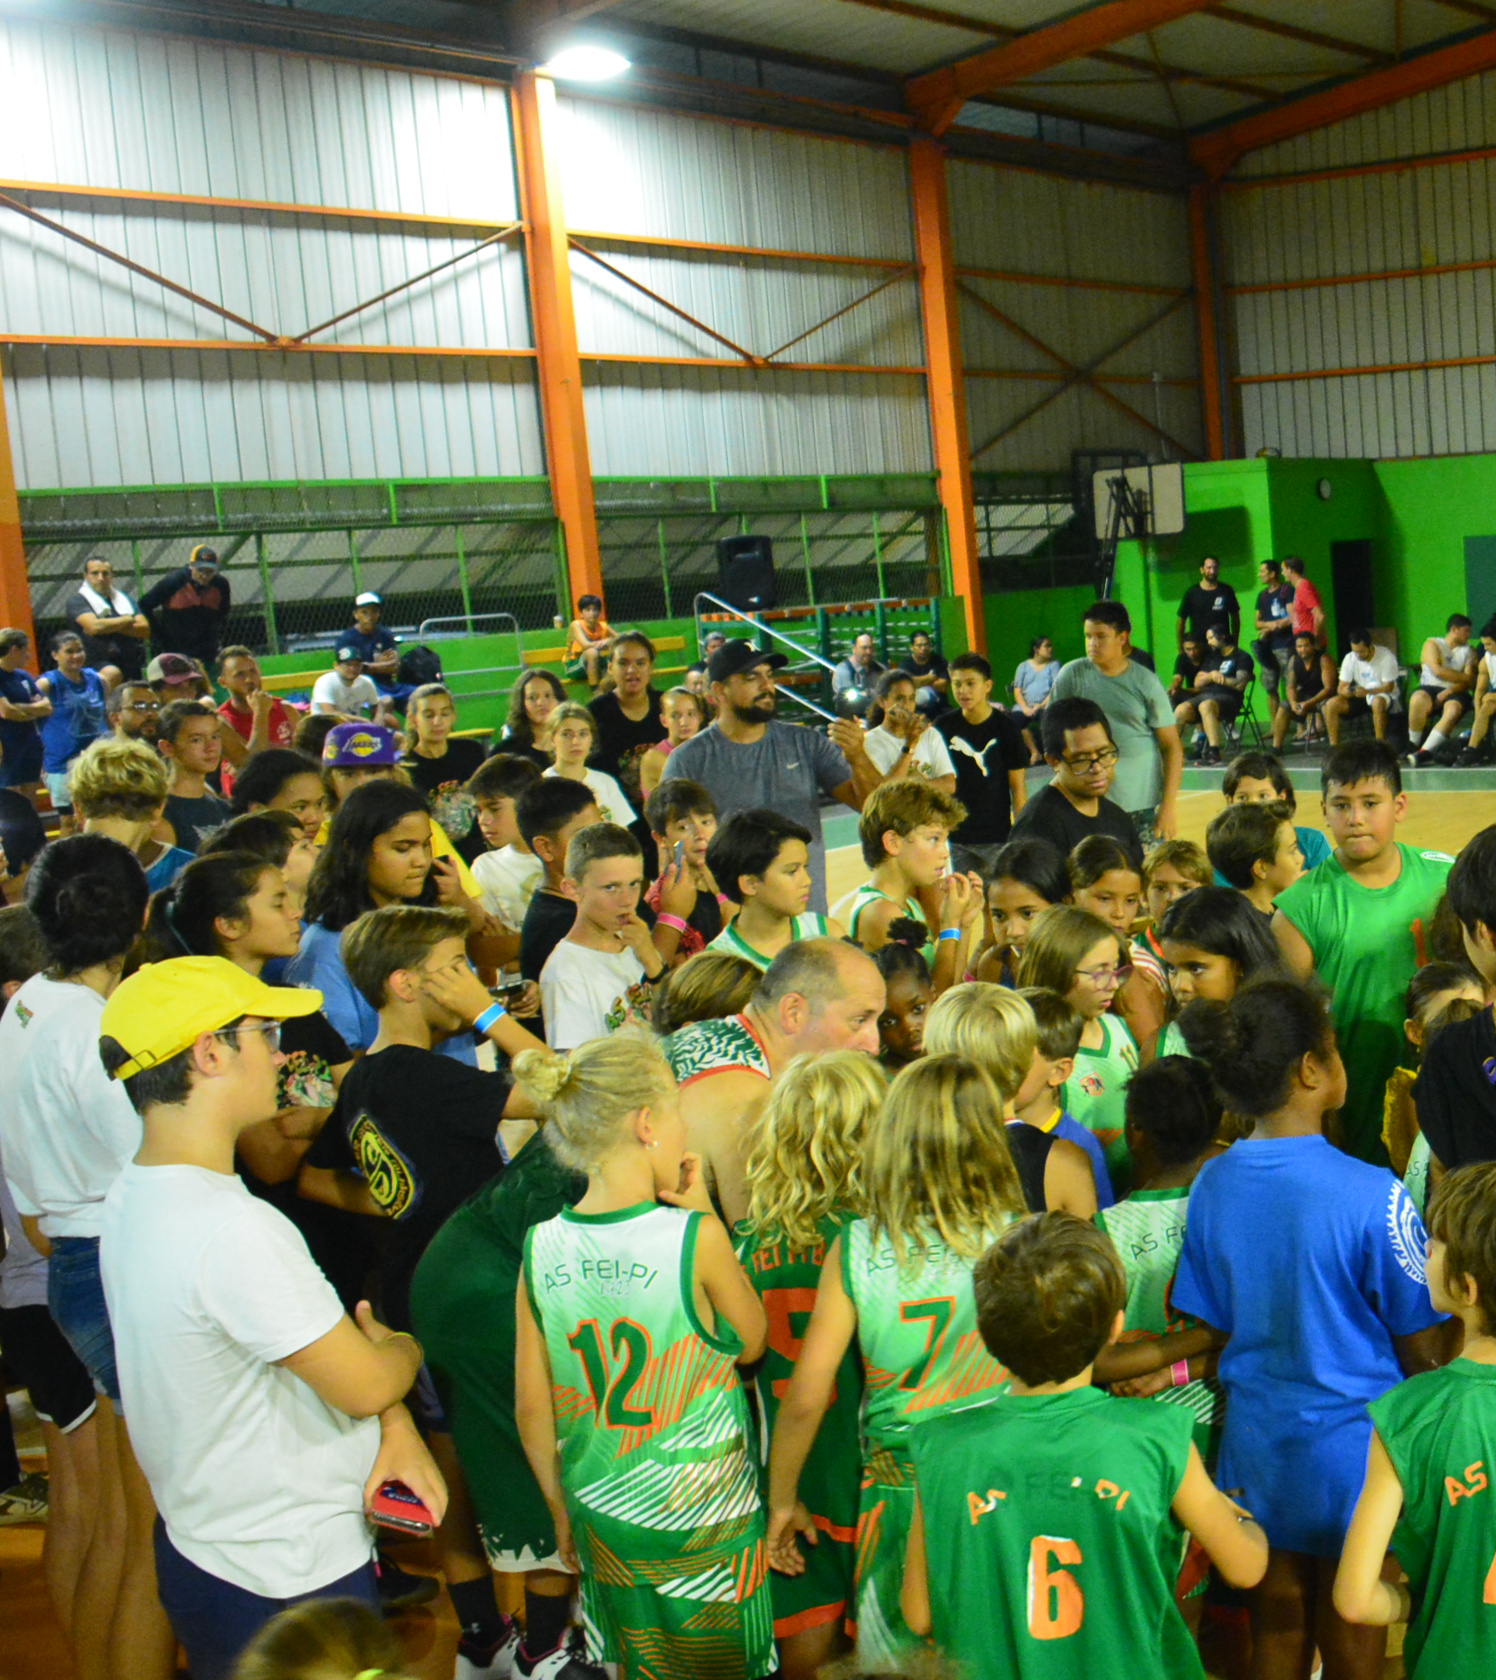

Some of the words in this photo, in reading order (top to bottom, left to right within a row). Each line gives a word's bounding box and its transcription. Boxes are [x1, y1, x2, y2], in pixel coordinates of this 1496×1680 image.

[866, 1247, 895, 1277] AS
[1130, 1232, 1158, 1260] AS
[545, 1264, 572, 1295] AS
[581, 1259, 658, 1290] FEI-PI
[899, 1296, 955, 1393] 7
[566, 1316, 661, 1431] 12
[1444, 1460, 1488, 1507] AS
[1027, 1534, 1085, 1640] 6
